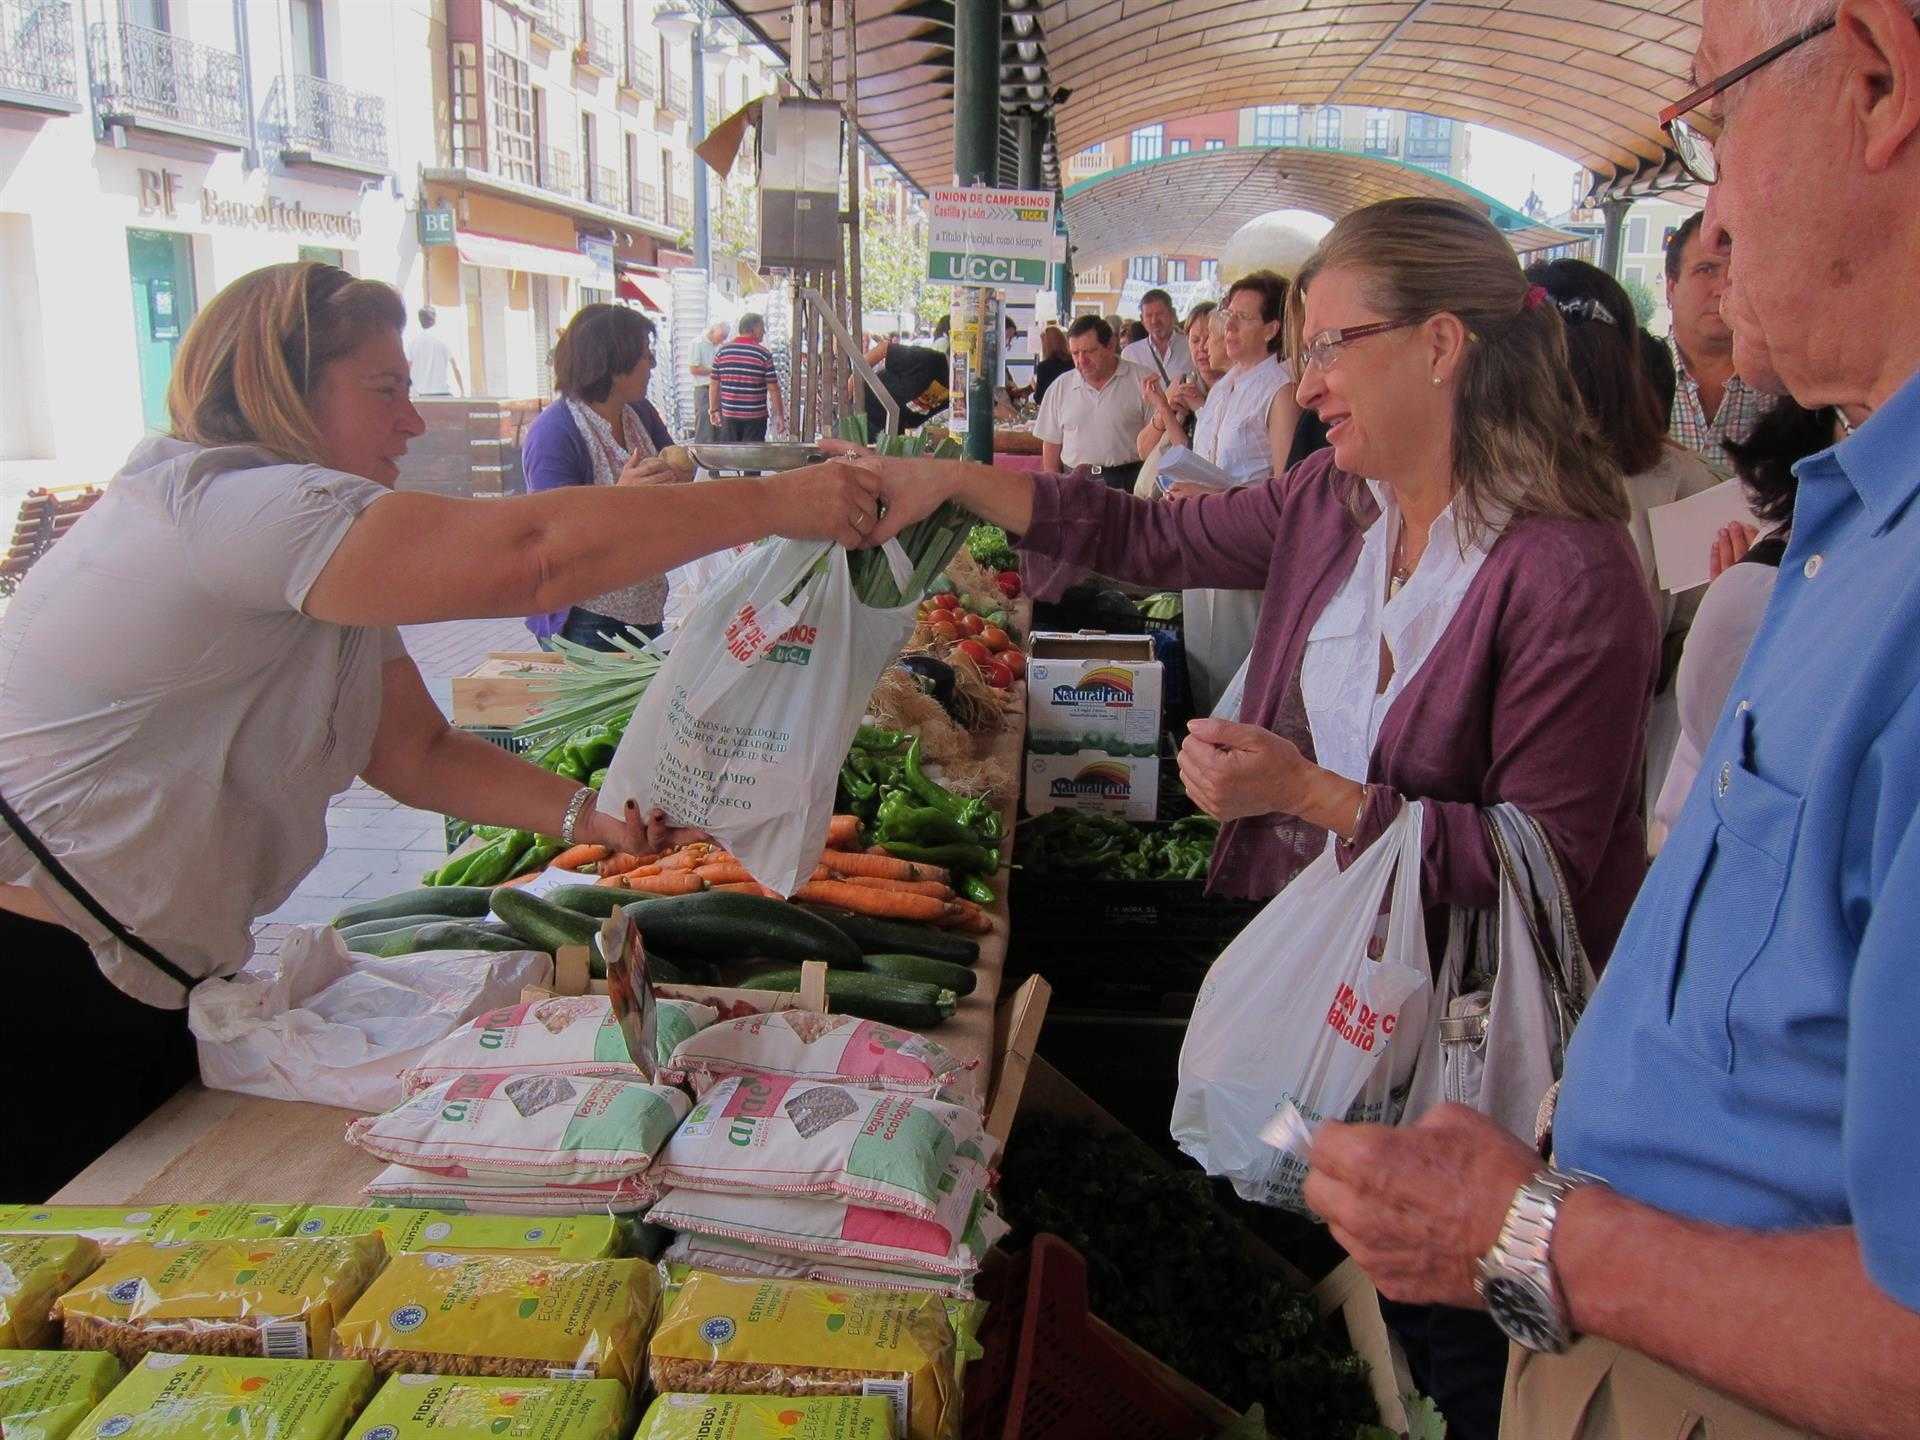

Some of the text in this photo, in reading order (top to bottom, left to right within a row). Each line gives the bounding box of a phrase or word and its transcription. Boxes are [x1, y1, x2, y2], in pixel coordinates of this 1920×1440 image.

[970, 192, 982, 203] DE
[986, 193, 1050, 208] CAMPESINOS
[934, 205, 961, 218] Castilla
[968, 207, 986, 219] León
[425, 213, 450, 232] BE
[996, 236, 1015, 246] como
[1015, 237, 1043, 249] siempre
[949, 256, 1025, 282] UCCL
[412, 1386, 443, 1422] FIDEOS
